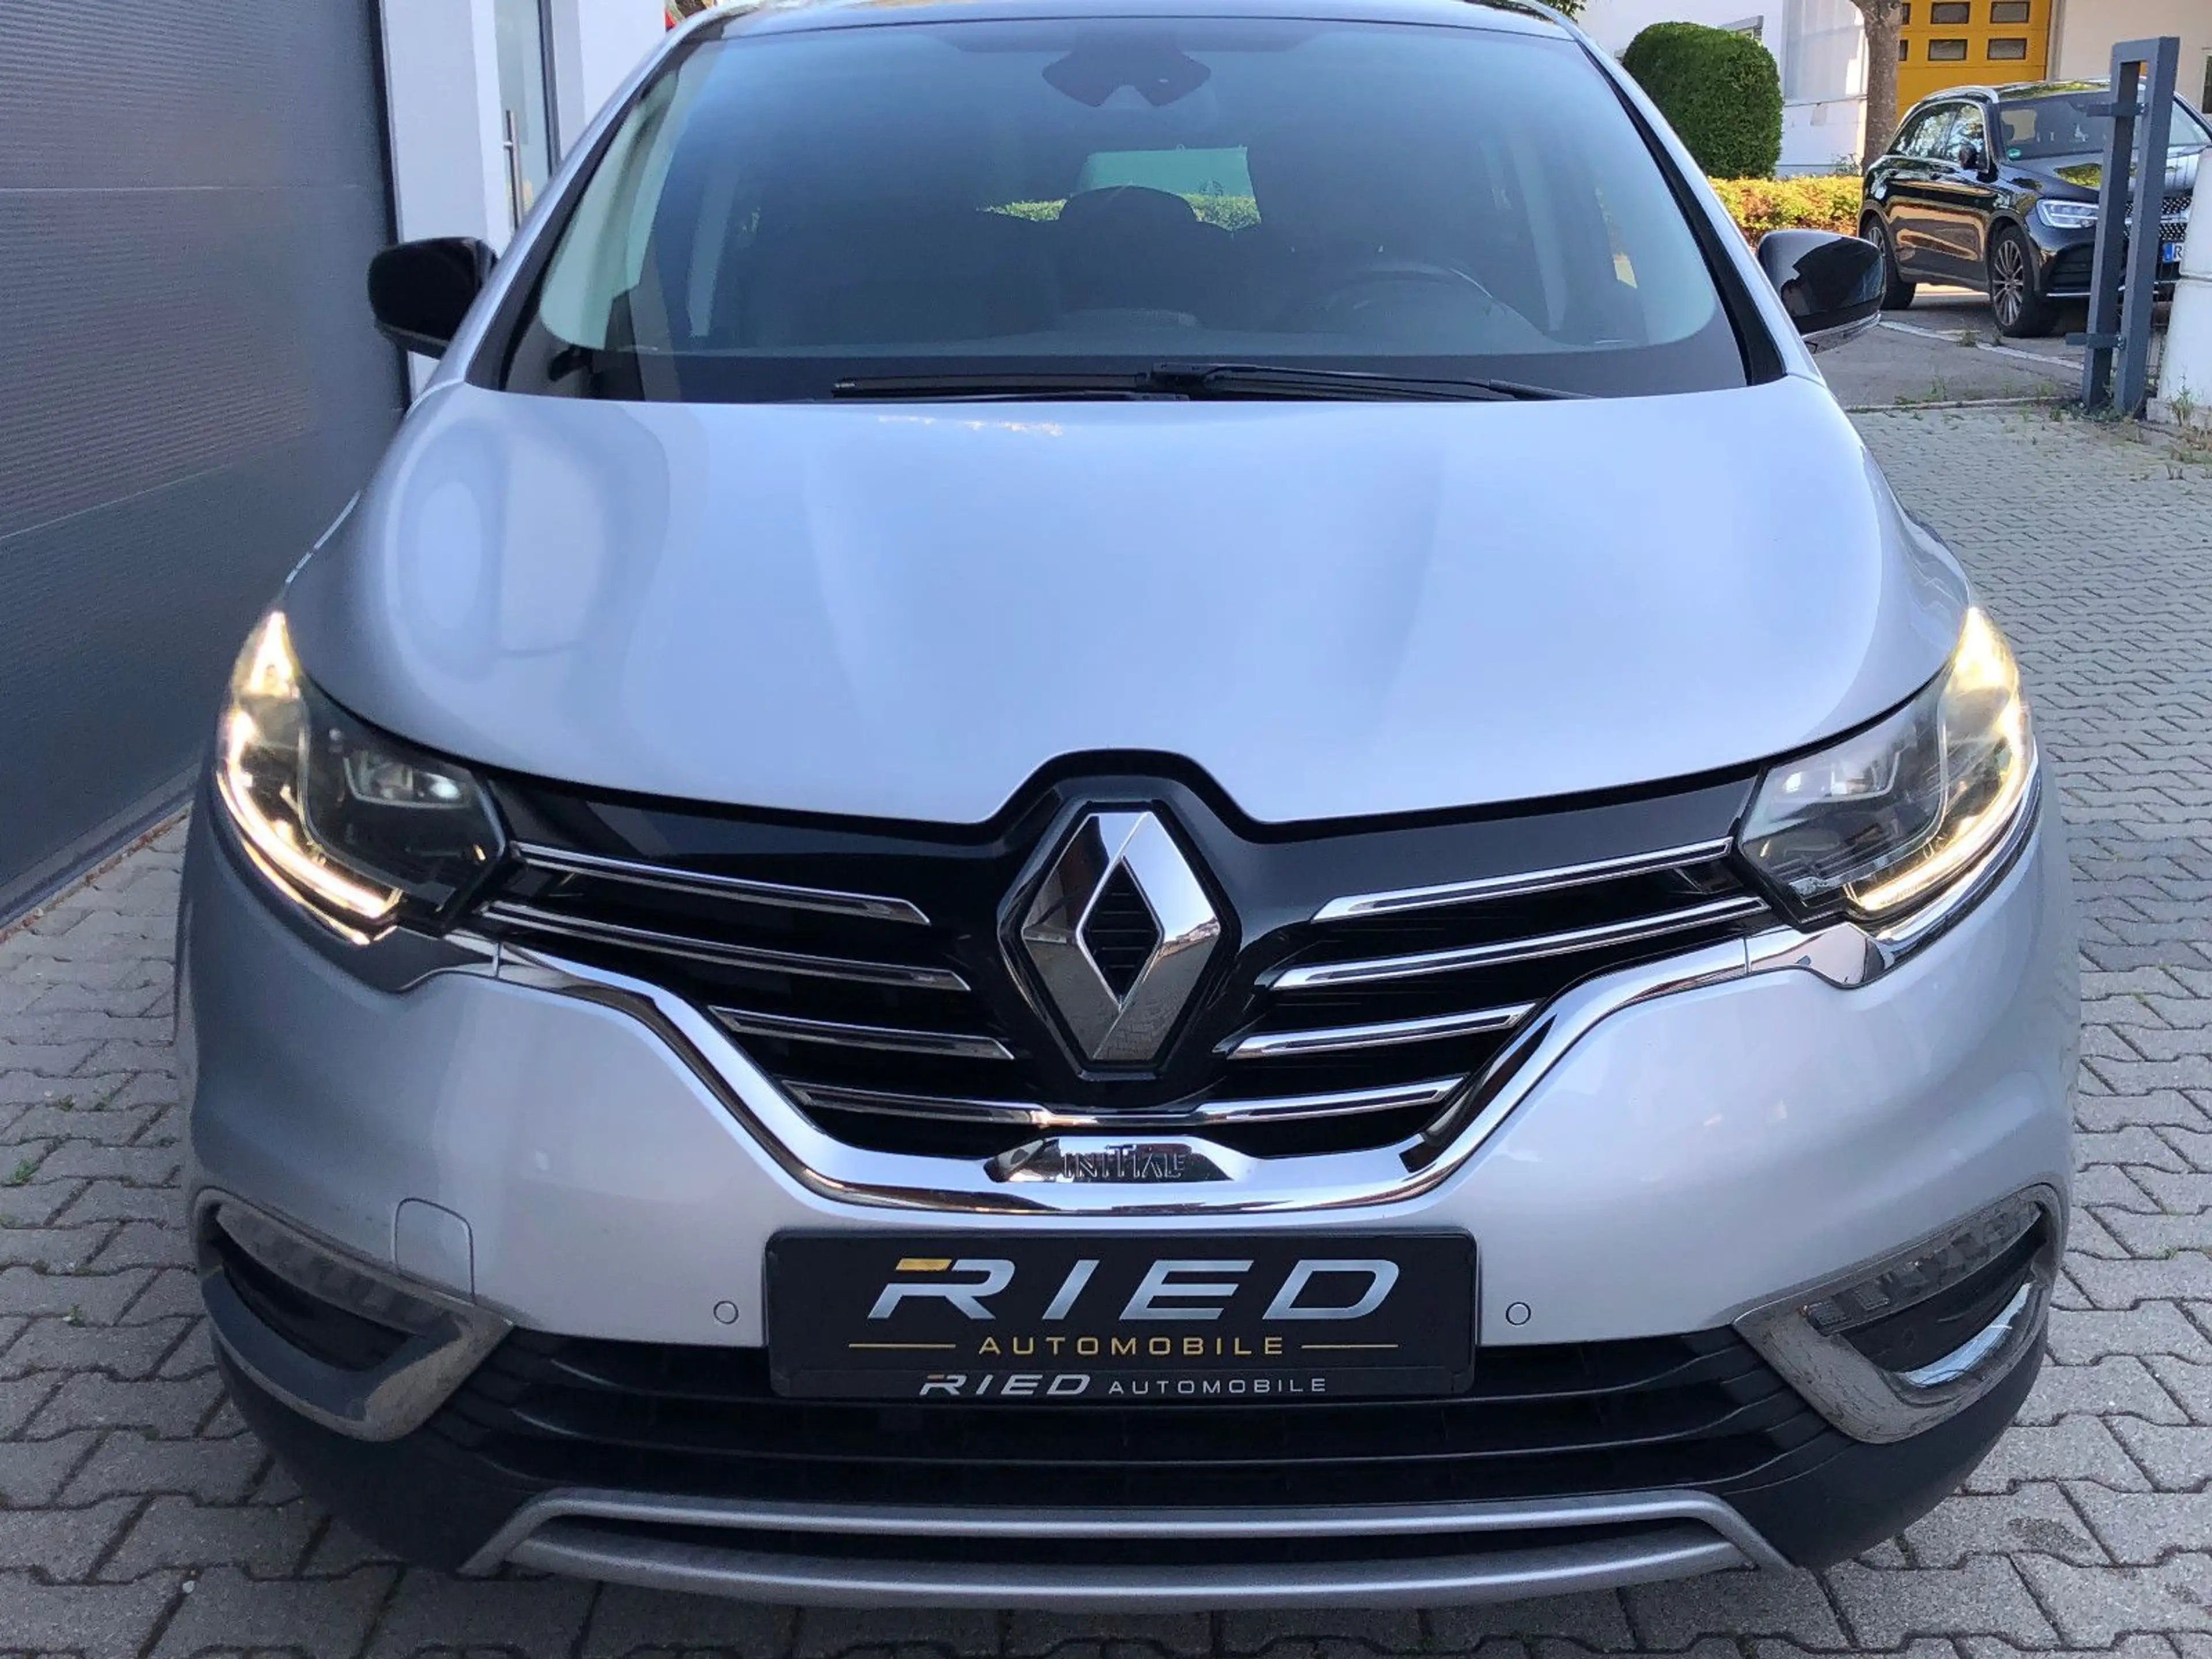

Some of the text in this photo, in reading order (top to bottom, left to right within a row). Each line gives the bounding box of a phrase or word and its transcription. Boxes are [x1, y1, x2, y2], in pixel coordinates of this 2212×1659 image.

[868, 1258, 1400, 1320] RIED
[979, 1336, 1282, 1355] AUTOMOBILE
[919, 1374, 1325, 1396] RIED AUTOMOBILE
